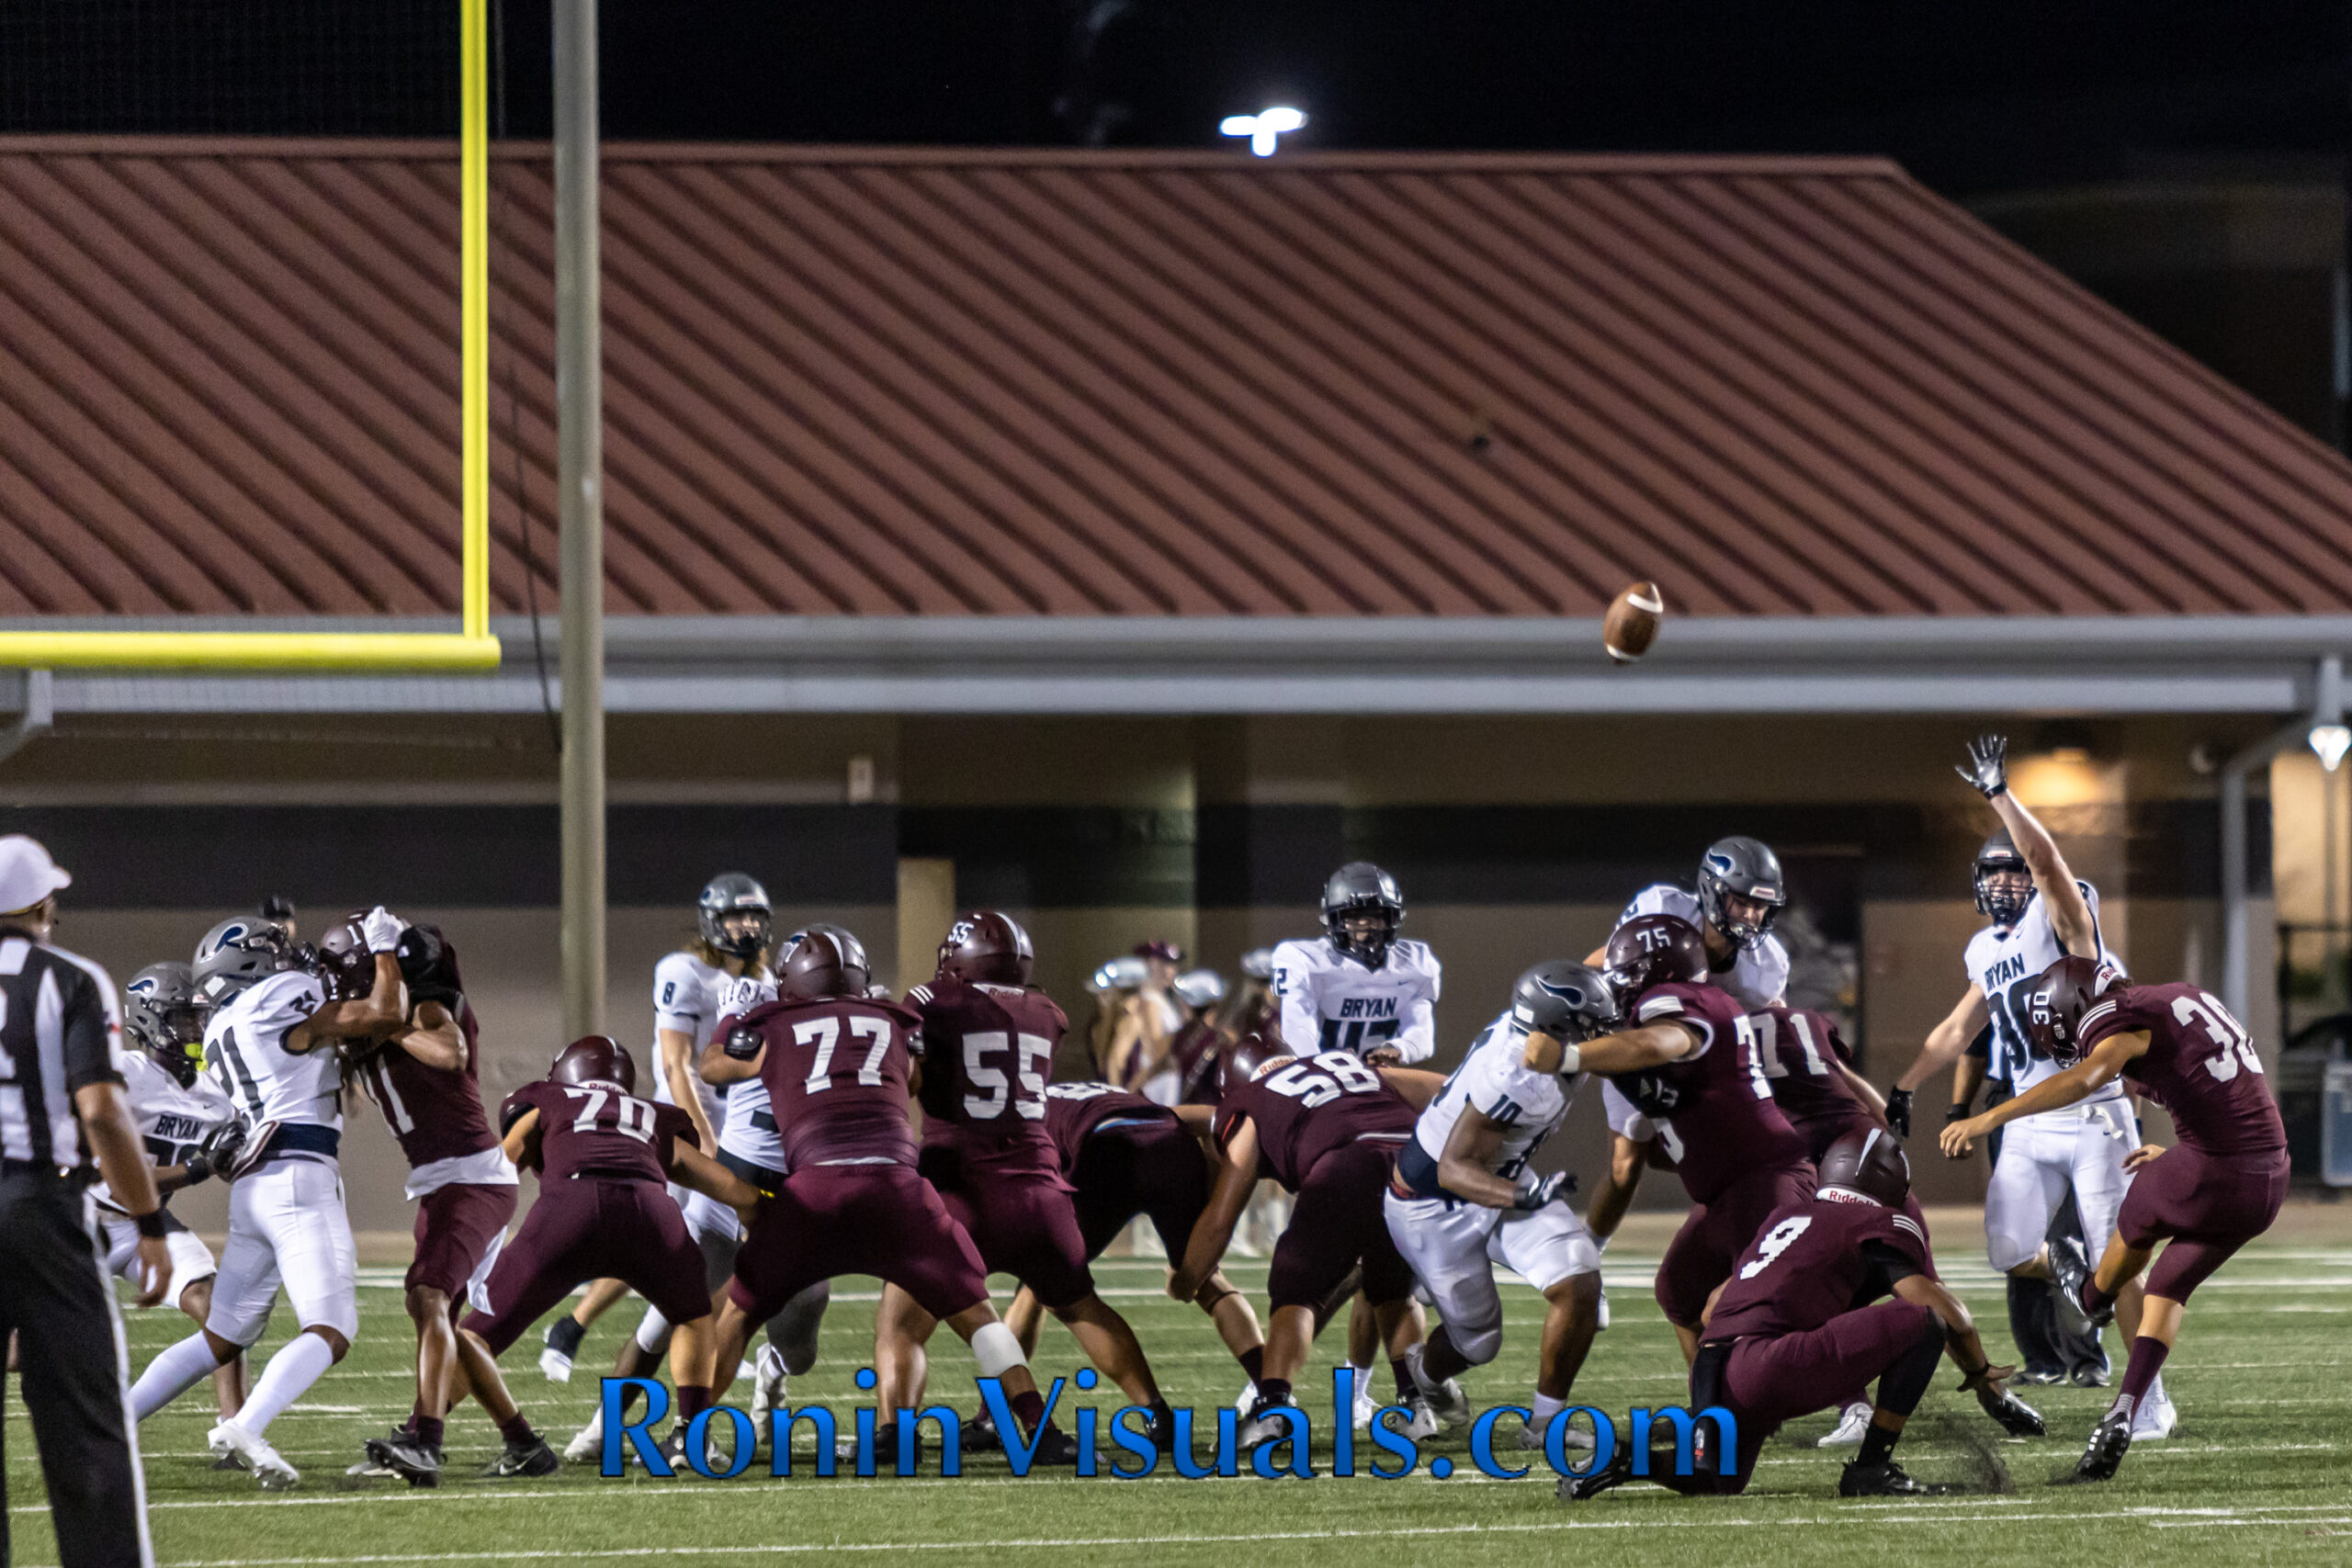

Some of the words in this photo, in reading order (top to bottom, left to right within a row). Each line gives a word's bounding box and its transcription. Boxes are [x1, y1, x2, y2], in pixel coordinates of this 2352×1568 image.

[947, 920, 975, 944] 55
[1635, 927, 1672, 953] 75
[1340, 997, 1398, 1018] BRYAN
[2032, 990, 2052, 1025] 30
[792, 1016, 891, 1095] 77
[1748, 1012, 1828, 1078] 71
[2170, 992, 2264, 1082] 30
[962, 1032, 1052, 1119] 55
[1264, 1051, 1381, 1109] 58
[153, 1114, 204, 1141] BRYAN
[563, 1088, 657, 1145] 70
[1739, 1215, 1814, 1280] 9
